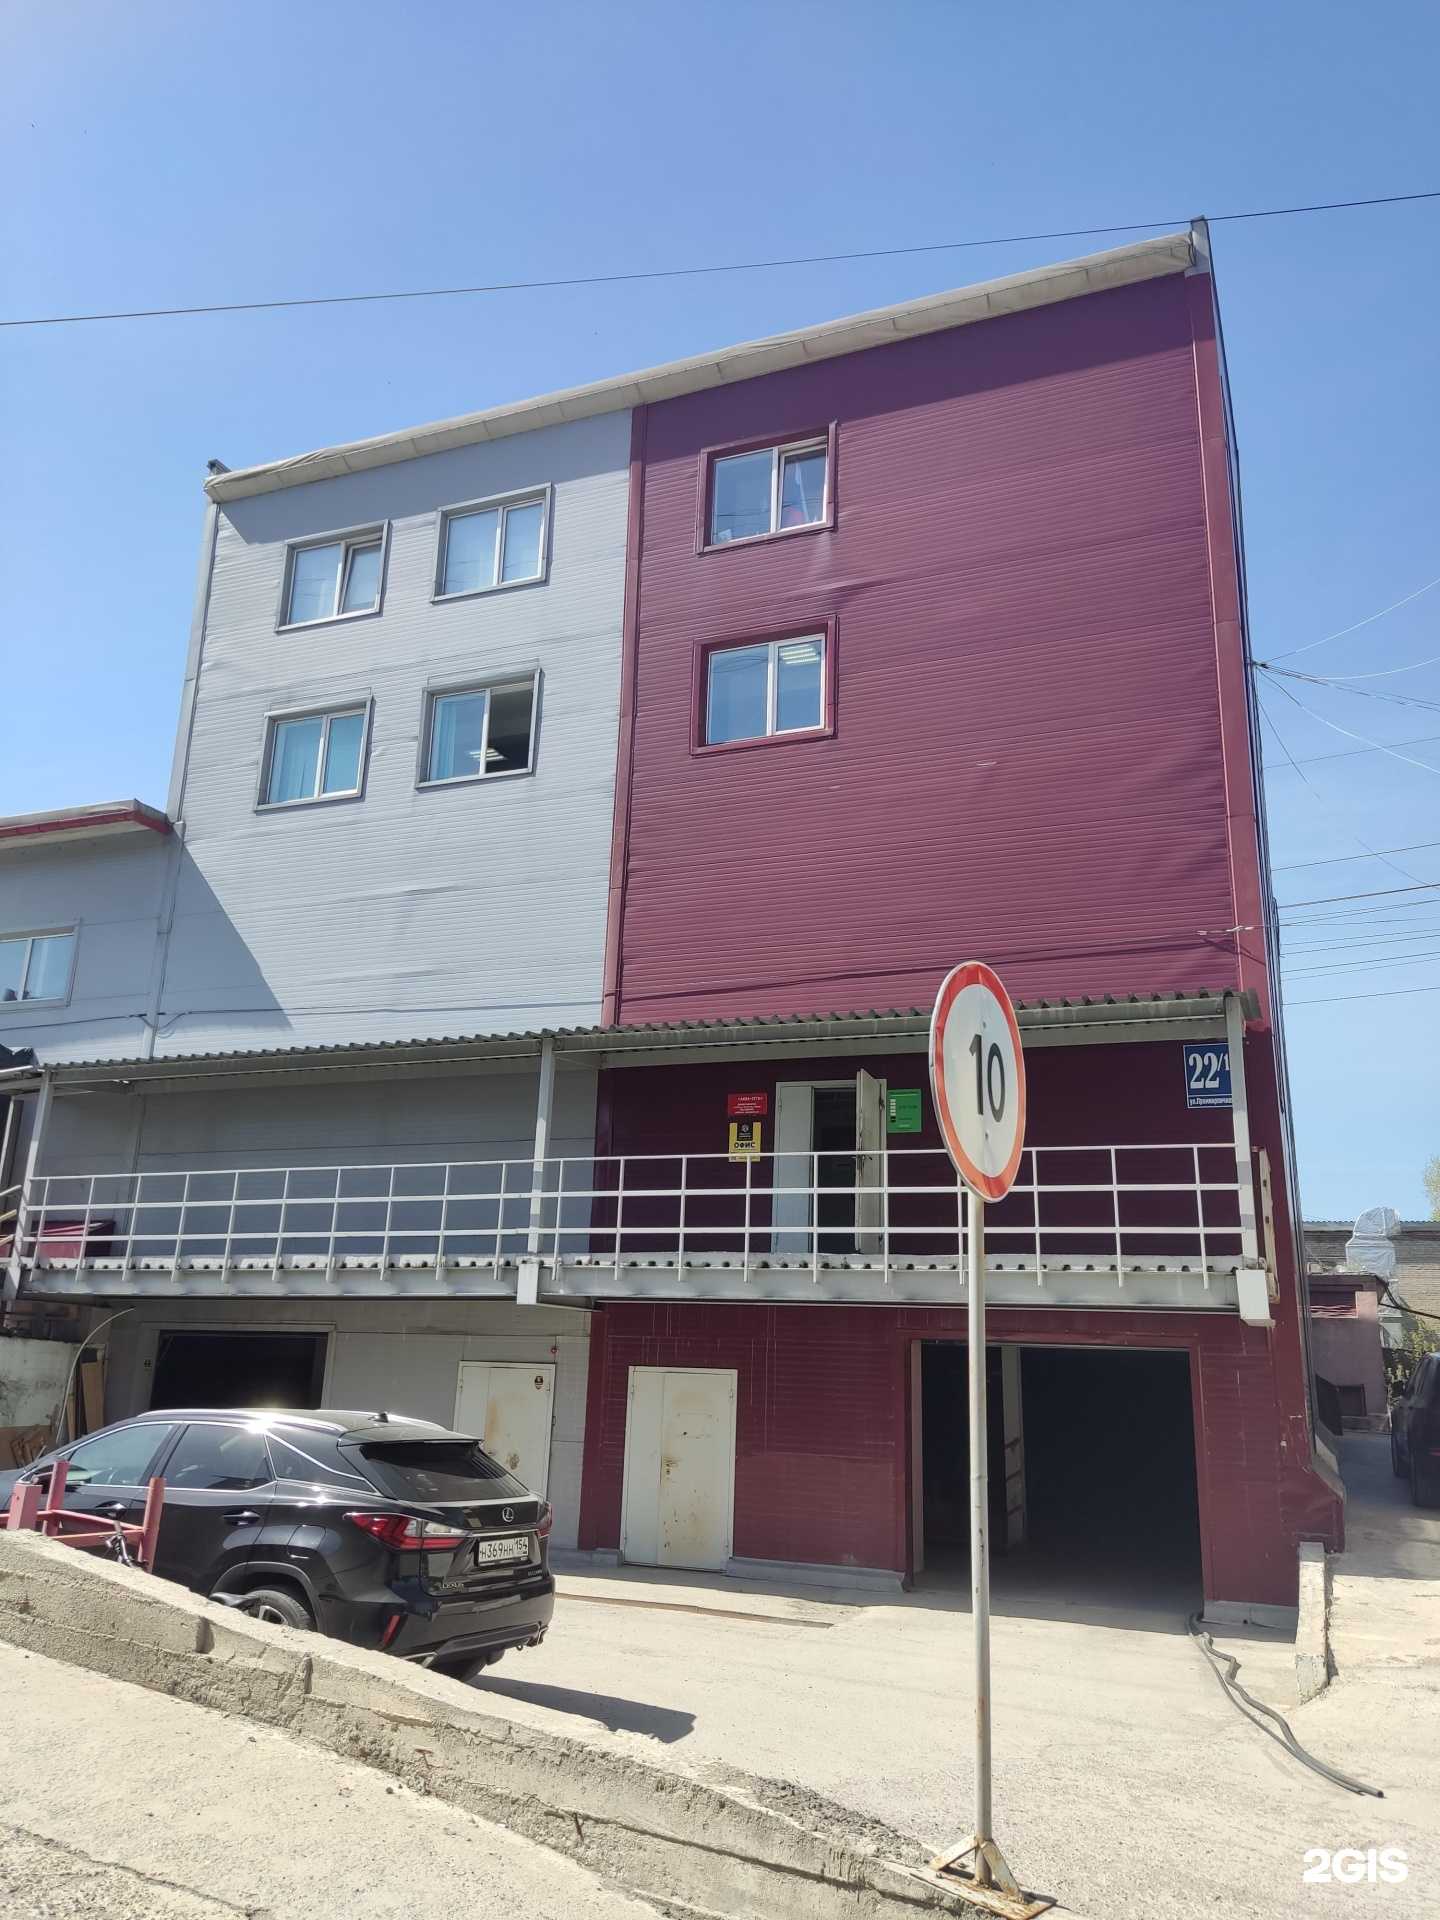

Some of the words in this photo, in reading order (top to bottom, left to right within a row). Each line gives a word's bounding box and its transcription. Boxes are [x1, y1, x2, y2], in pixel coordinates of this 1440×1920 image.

[968, 1033, 1006, 1123] 10
[1188, 1052, 1230, 1089] 22/1
[734, 1141, 756, 1149] ОФИС
